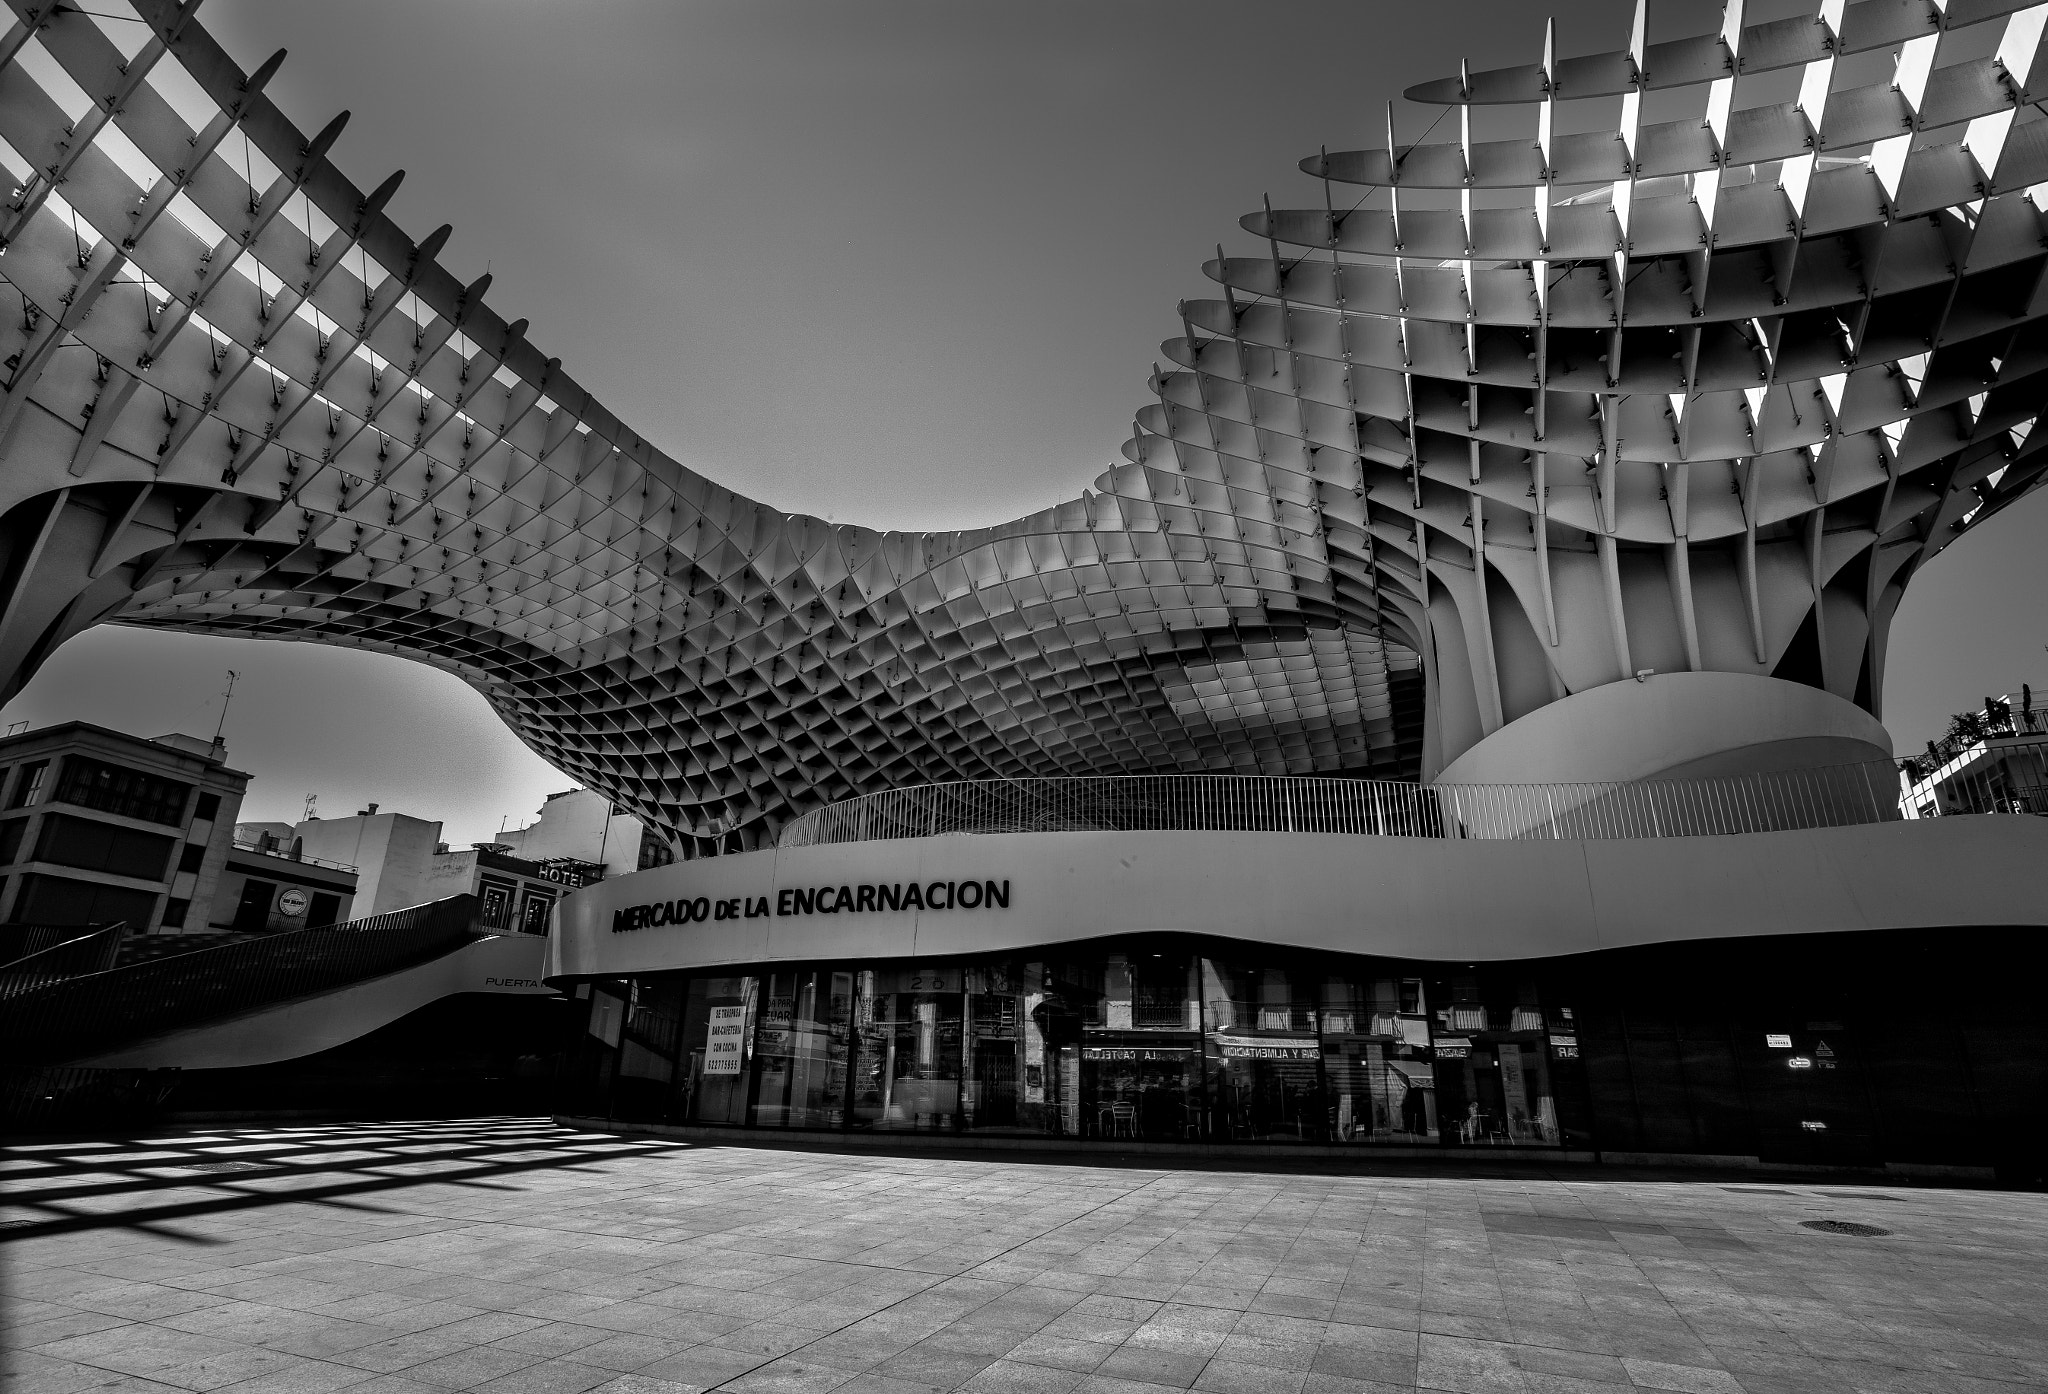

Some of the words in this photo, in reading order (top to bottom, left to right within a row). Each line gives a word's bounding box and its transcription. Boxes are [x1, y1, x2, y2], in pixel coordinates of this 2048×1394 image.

[612, 896, 710, 934] MERCADO
[714, 899, 741, 920] DE
[744, 897, 769, 918] LA
[777, 880, 1010, 916] ENCARNACION
[485, 977, 538, 988] PUERTA
[715, 1009, 721, 1019] SE
[722, 1008, 741, 1018] TRASPASA
[713, 1043, 722, 1052] CON
[722, 1042, 737, 1052] COCINA
